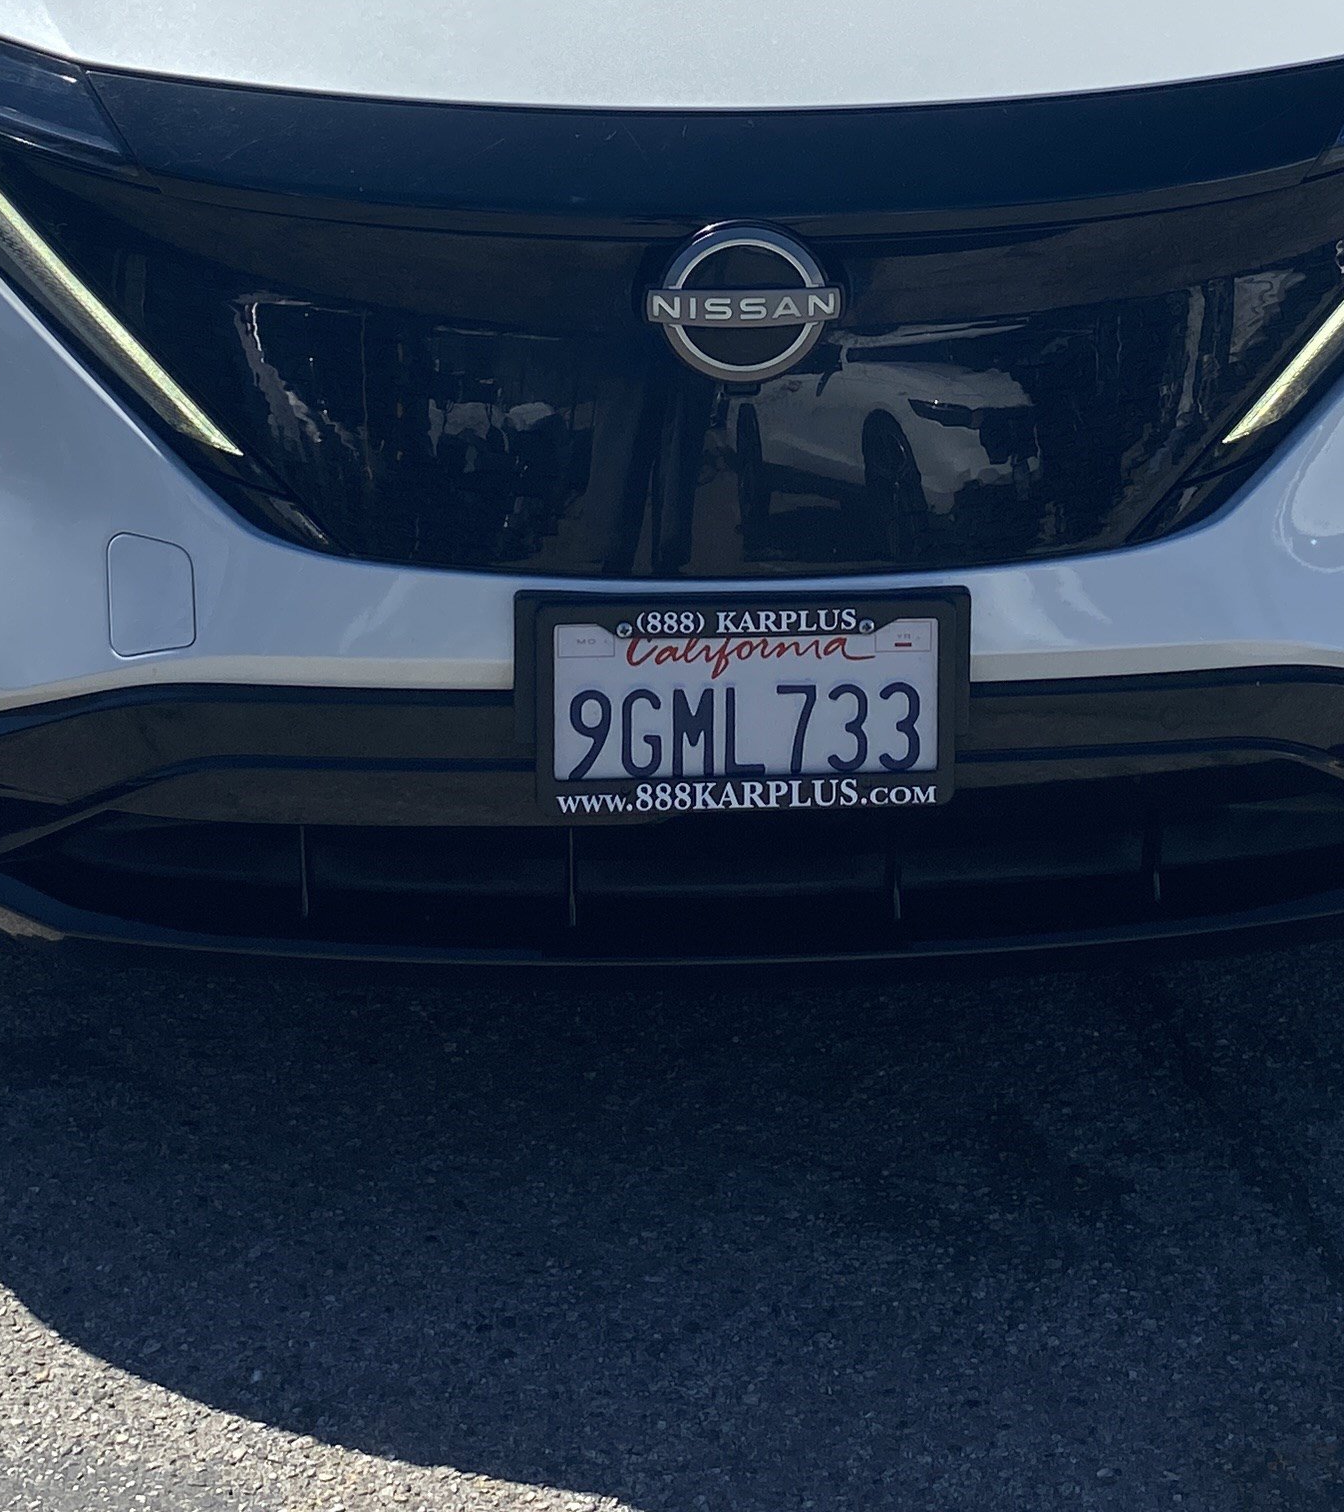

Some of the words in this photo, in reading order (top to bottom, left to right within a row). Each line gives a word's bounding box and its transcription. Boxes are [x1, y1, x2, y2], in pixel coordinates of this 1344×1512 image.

[652, 293, 835, 320] NISSAN
[636, 610, 705, 635] (888)
[717, 608, 857, 634] KARPLUS
[626, 636, 875, 679] California
[569, 681, 921, 780] 9GML733
